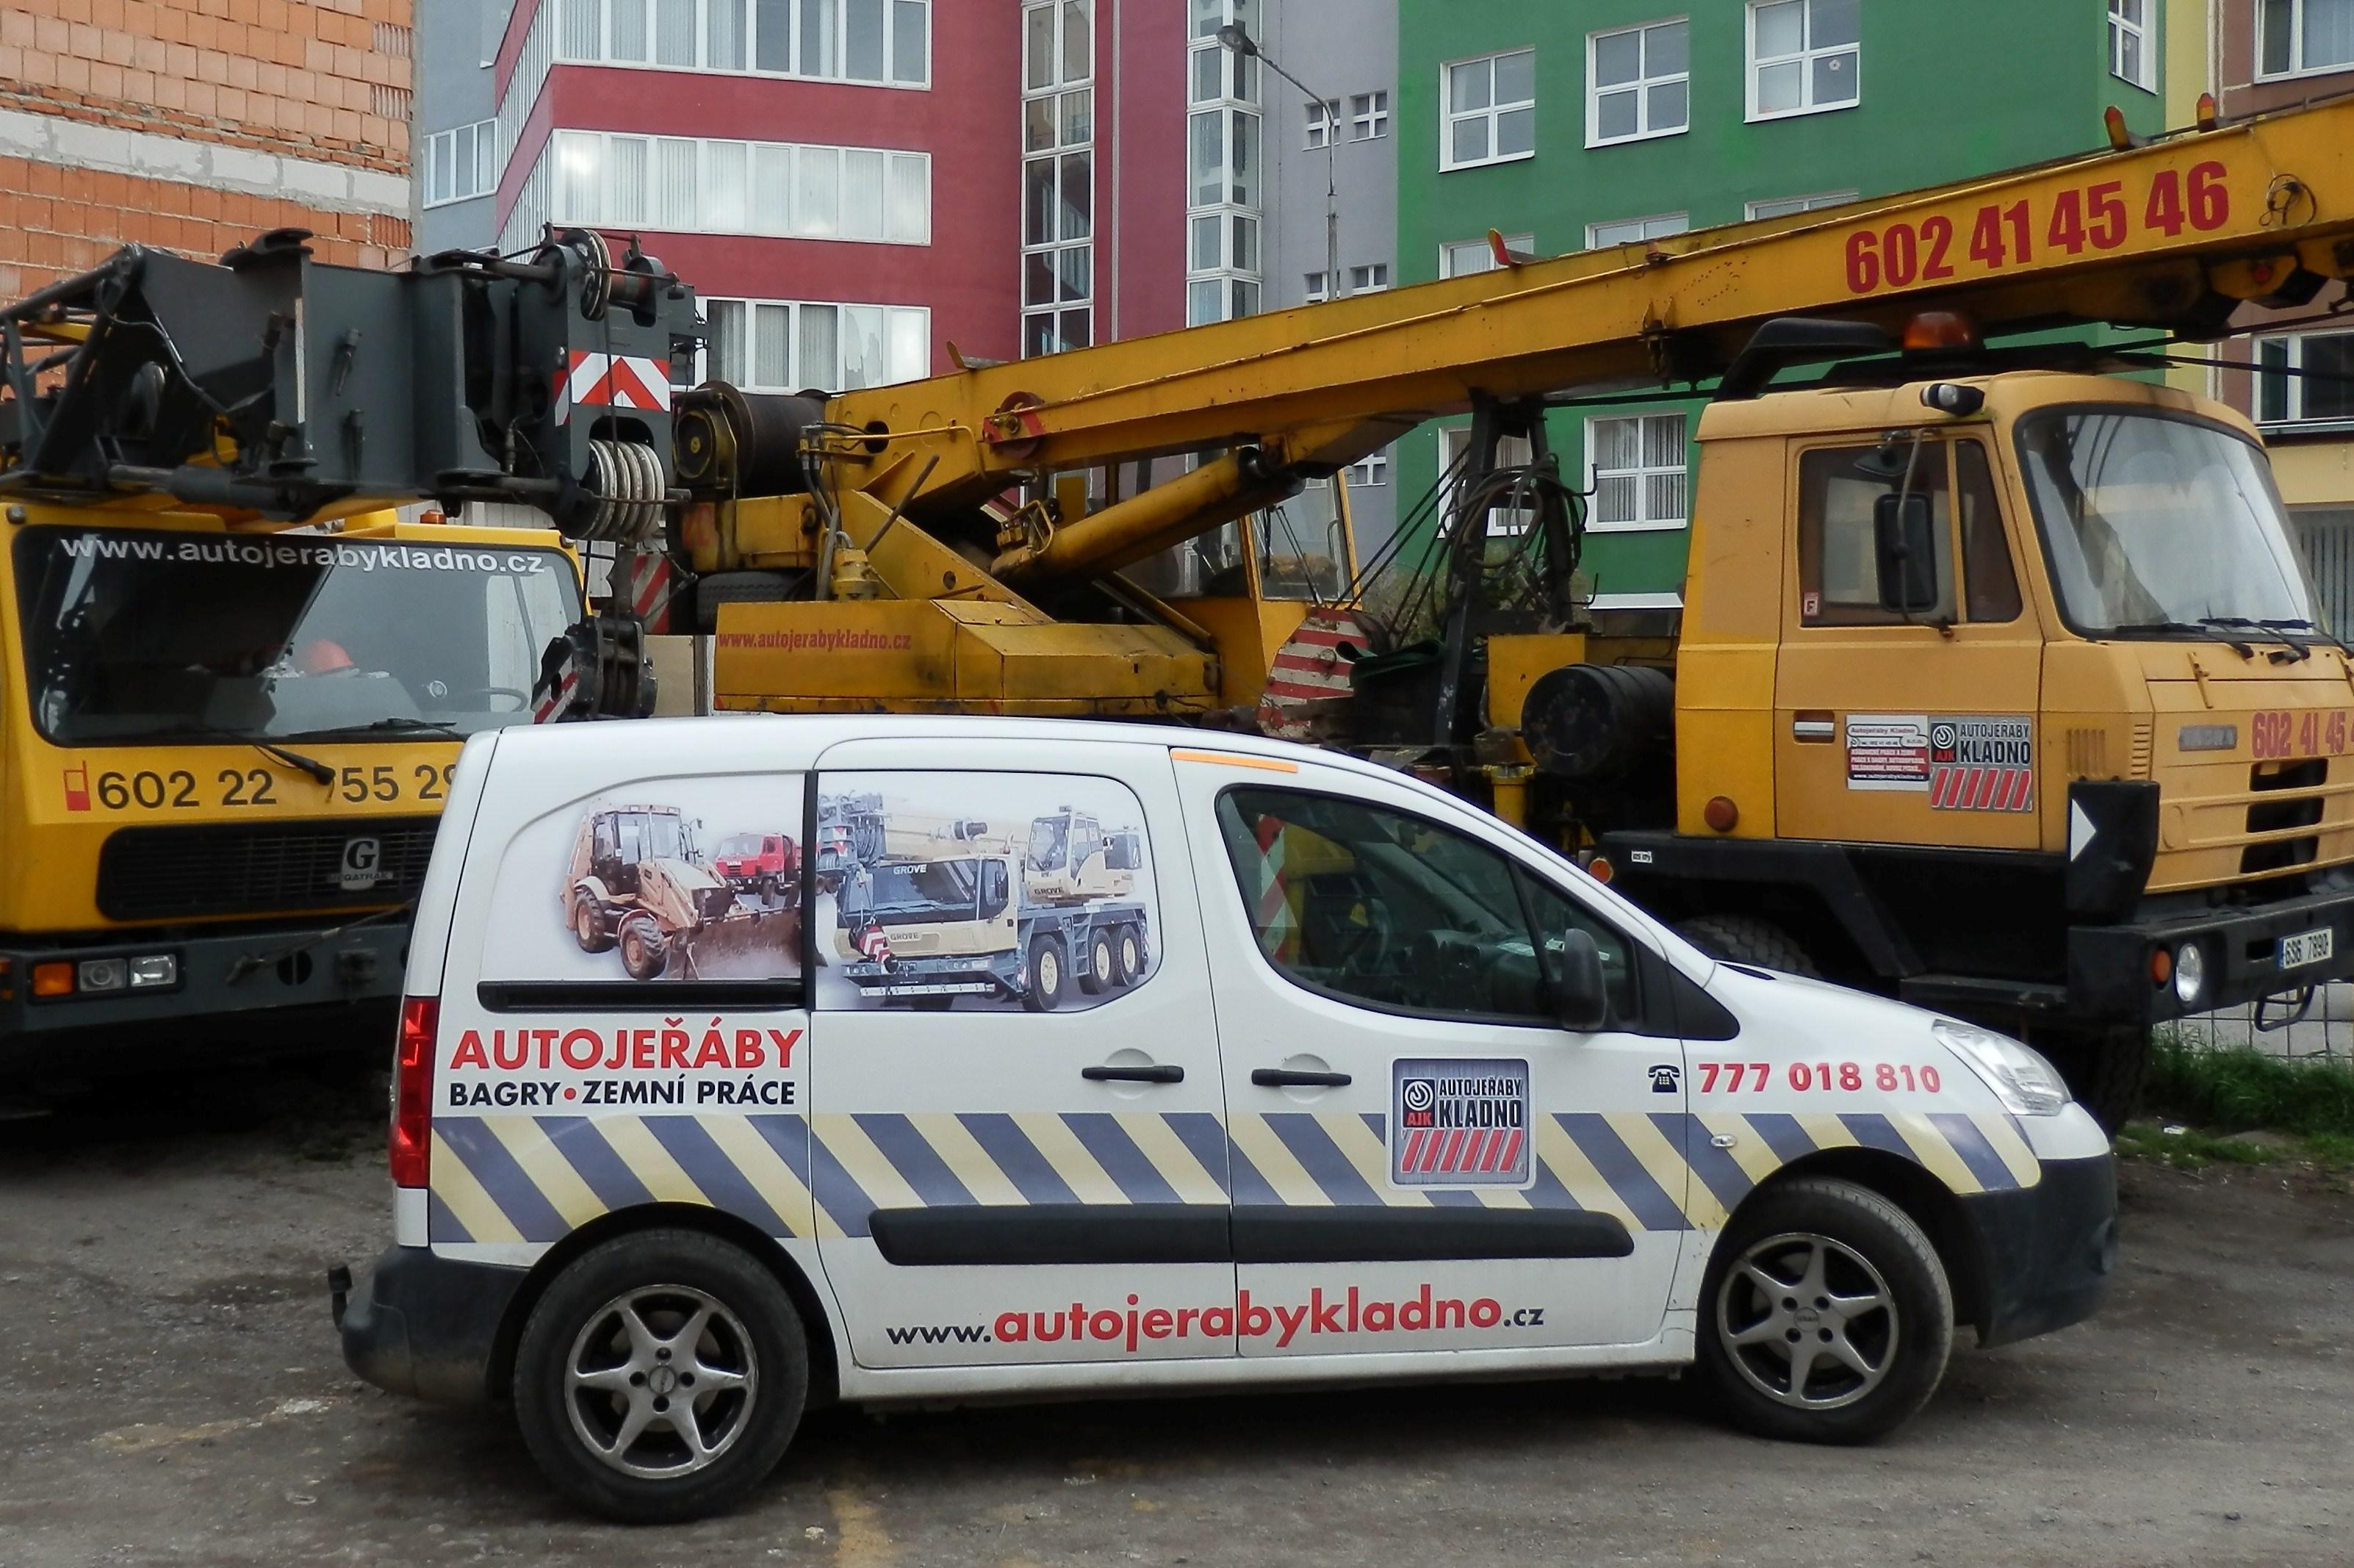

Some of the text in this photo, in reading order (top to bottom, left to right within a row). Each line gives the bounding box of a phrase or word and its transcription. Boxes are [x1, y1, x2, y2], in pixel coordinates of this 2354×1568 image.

[1846, 160, 2229, 294] 602 41 45 46
[61, 538, 544, 573] www.autojerabykladno.cz
[719, 629, 912, 652] www.autojerabykladno.cz
[1959, 720, 2029, 738] AUTOJEŘÁBY
[2252, 711, 2292, 759] 602
[2300, 712, 2318, 756] 41
[2325, 711, 2346, 755] 45
[1936, 749, 1954, 762] AJK
[1959, 741, 2031, 763] KLADNO
[98, 770, 200, 810] 602
[218, 769, 277, 805] 22
[342, 766, 399, 803] 55
[347, 841, 376, 870] G
[893, 863, 927, 875] GROVE
[1034, 886, 1064, 895] GROVE
[890, 932, 919, 941] GROVE
[450, 1016, 804, 1070] AUTOJEŘÁBY
[450, 1073, 796, 1107] BAGRY ZEMNÍ PRÁCE
[1439, 1076, 1522, 1096] AUTOJEŘÁBY
[1699, 1062, 1940, 1093] 777 018 810
[1406, 1112, 1433, 1126] AJK
[1439, 1099, 1522, 1128] KLADNO
[886, 1283, 1545, 1353] www.autojerabykladno.cz
